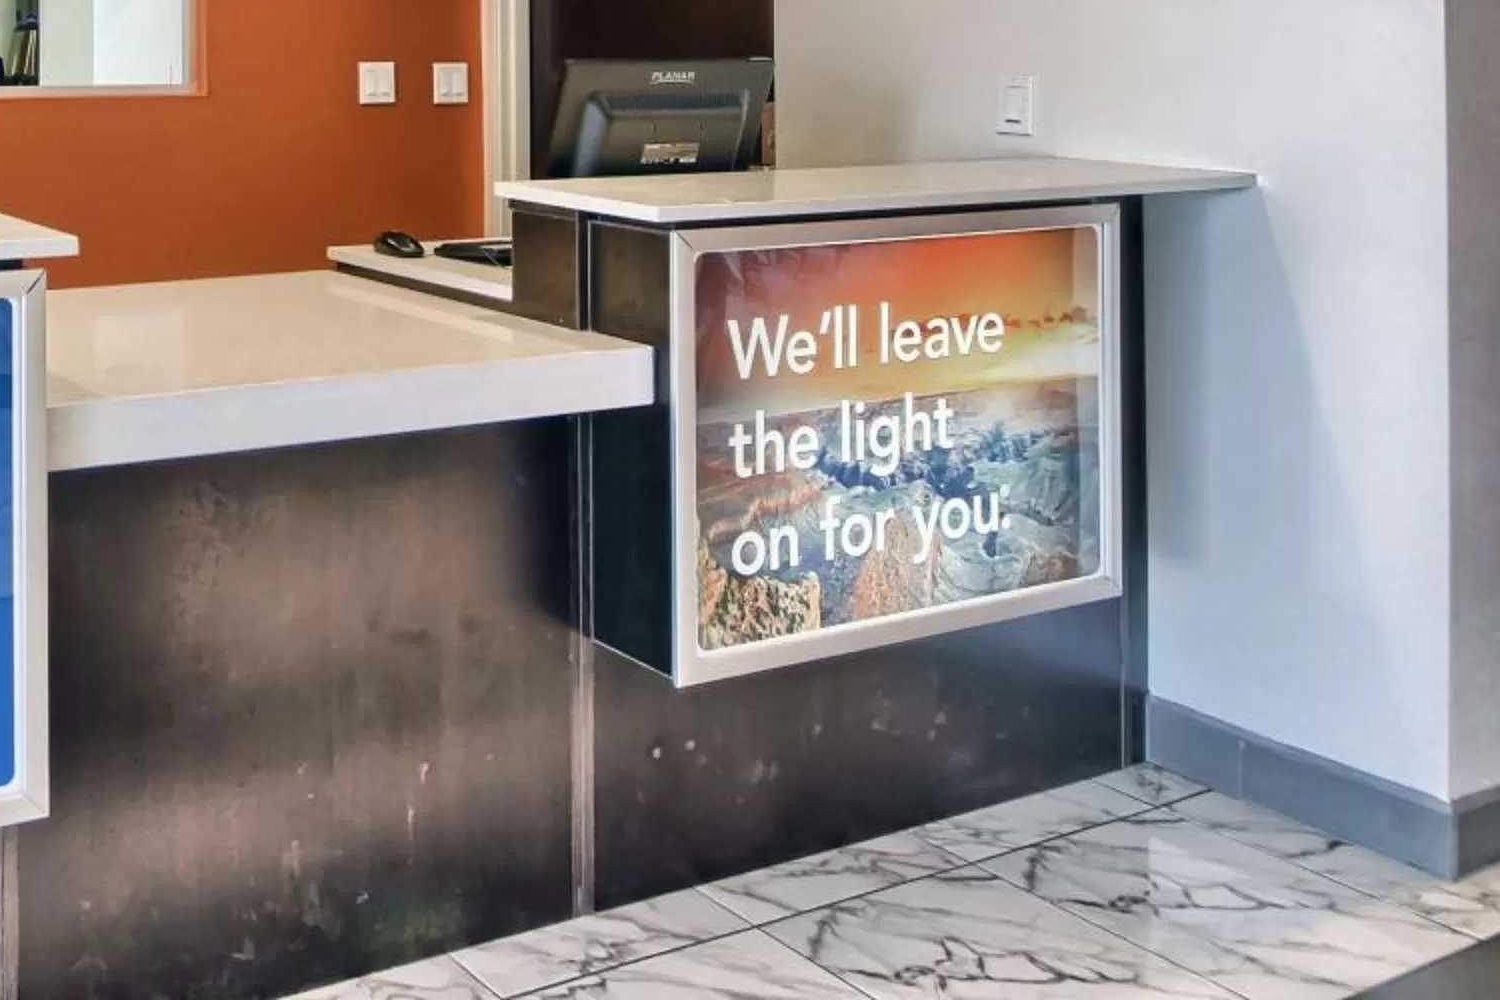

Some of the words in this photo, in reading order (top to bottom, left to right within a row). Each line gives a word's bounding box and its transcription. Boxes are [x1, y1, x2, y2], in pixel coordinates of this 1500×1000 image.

[651, 71, 695, 82] PLANAR
[727, 304, 859, 379] We'll
[880, 301, 1005, 365] leave
[728, 409, 819, 479] the
[840, 392, 954, 477] light
[731, 523, 799, 577] on
[819, 496, 896, 562] for
